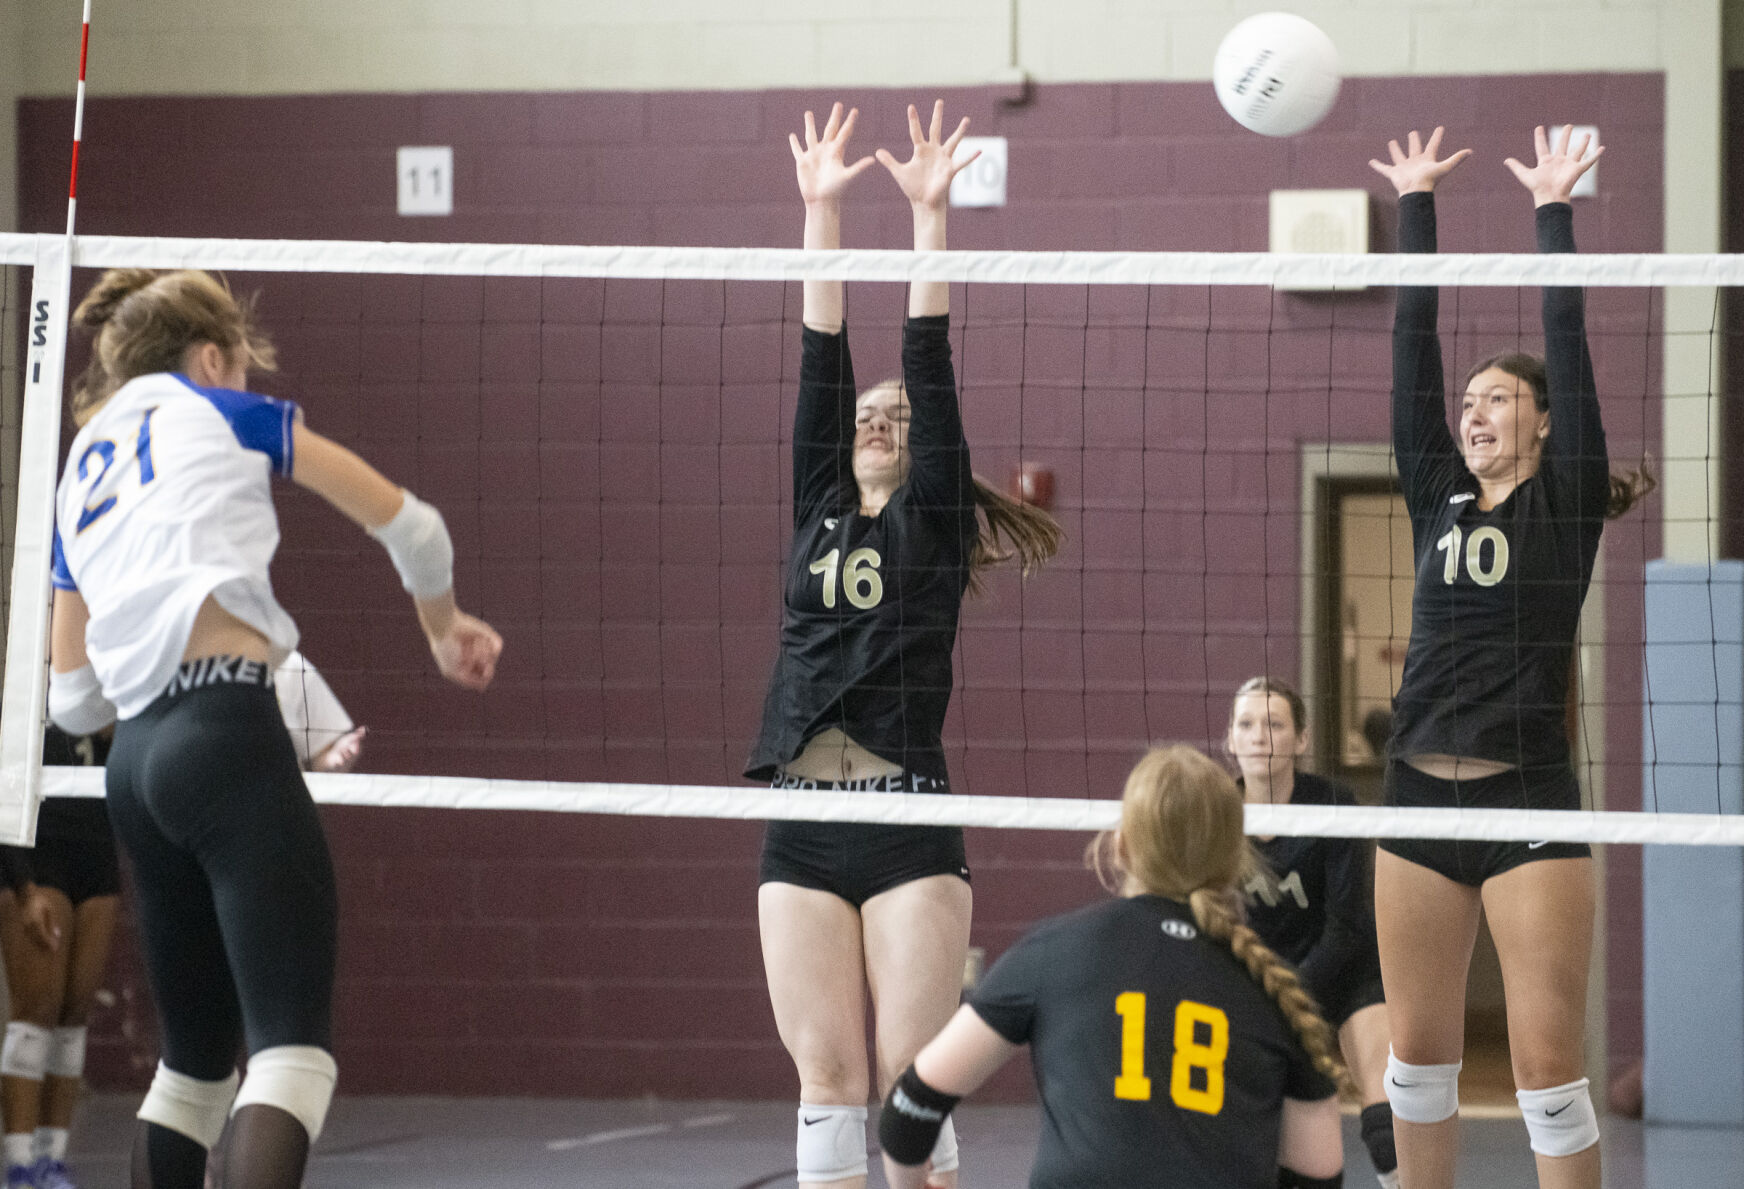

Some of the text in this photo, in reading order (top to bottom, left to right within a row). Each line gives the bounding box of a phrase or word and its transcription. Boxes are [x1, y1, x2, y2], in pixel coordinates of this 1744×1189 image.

[406, 166, 442, 199] 11
[963, 155, 1001, 191] 10
[76, 405, 160, 535] 21
[810, 547, 883, 610] 16
[1437, 524, 1509, 587] 10
[168, 654, 260, 697] NIKE
[1114, 991, 1230, 1116] 18
